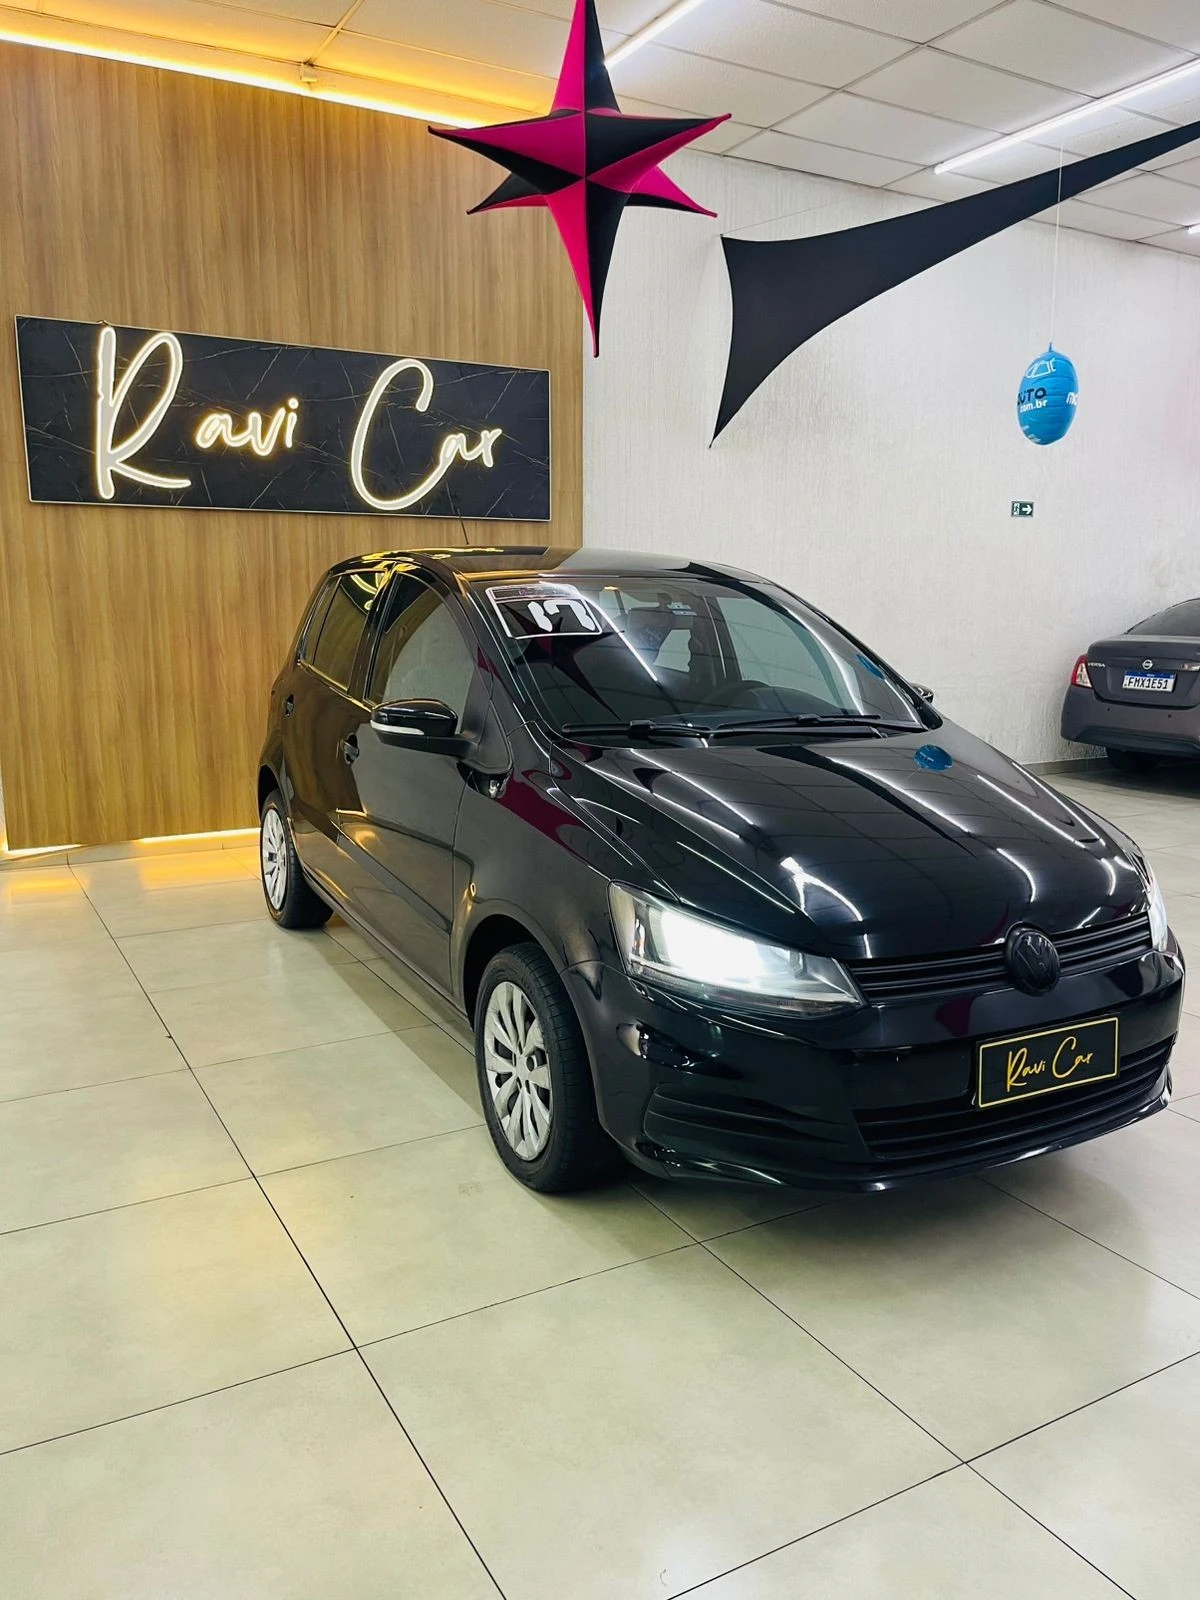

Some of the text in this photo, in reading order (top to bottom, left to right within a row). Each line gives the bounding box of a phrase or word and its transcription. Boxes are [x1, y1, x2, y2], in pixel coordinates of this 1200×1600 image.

[96, 326, 502, 510] Ravi Car
[527, 599, 596, 632] 17
[1127, 676, 1169, 690] FMX1E51
[1006, 1036, 1094, 1092] Ravi Car
